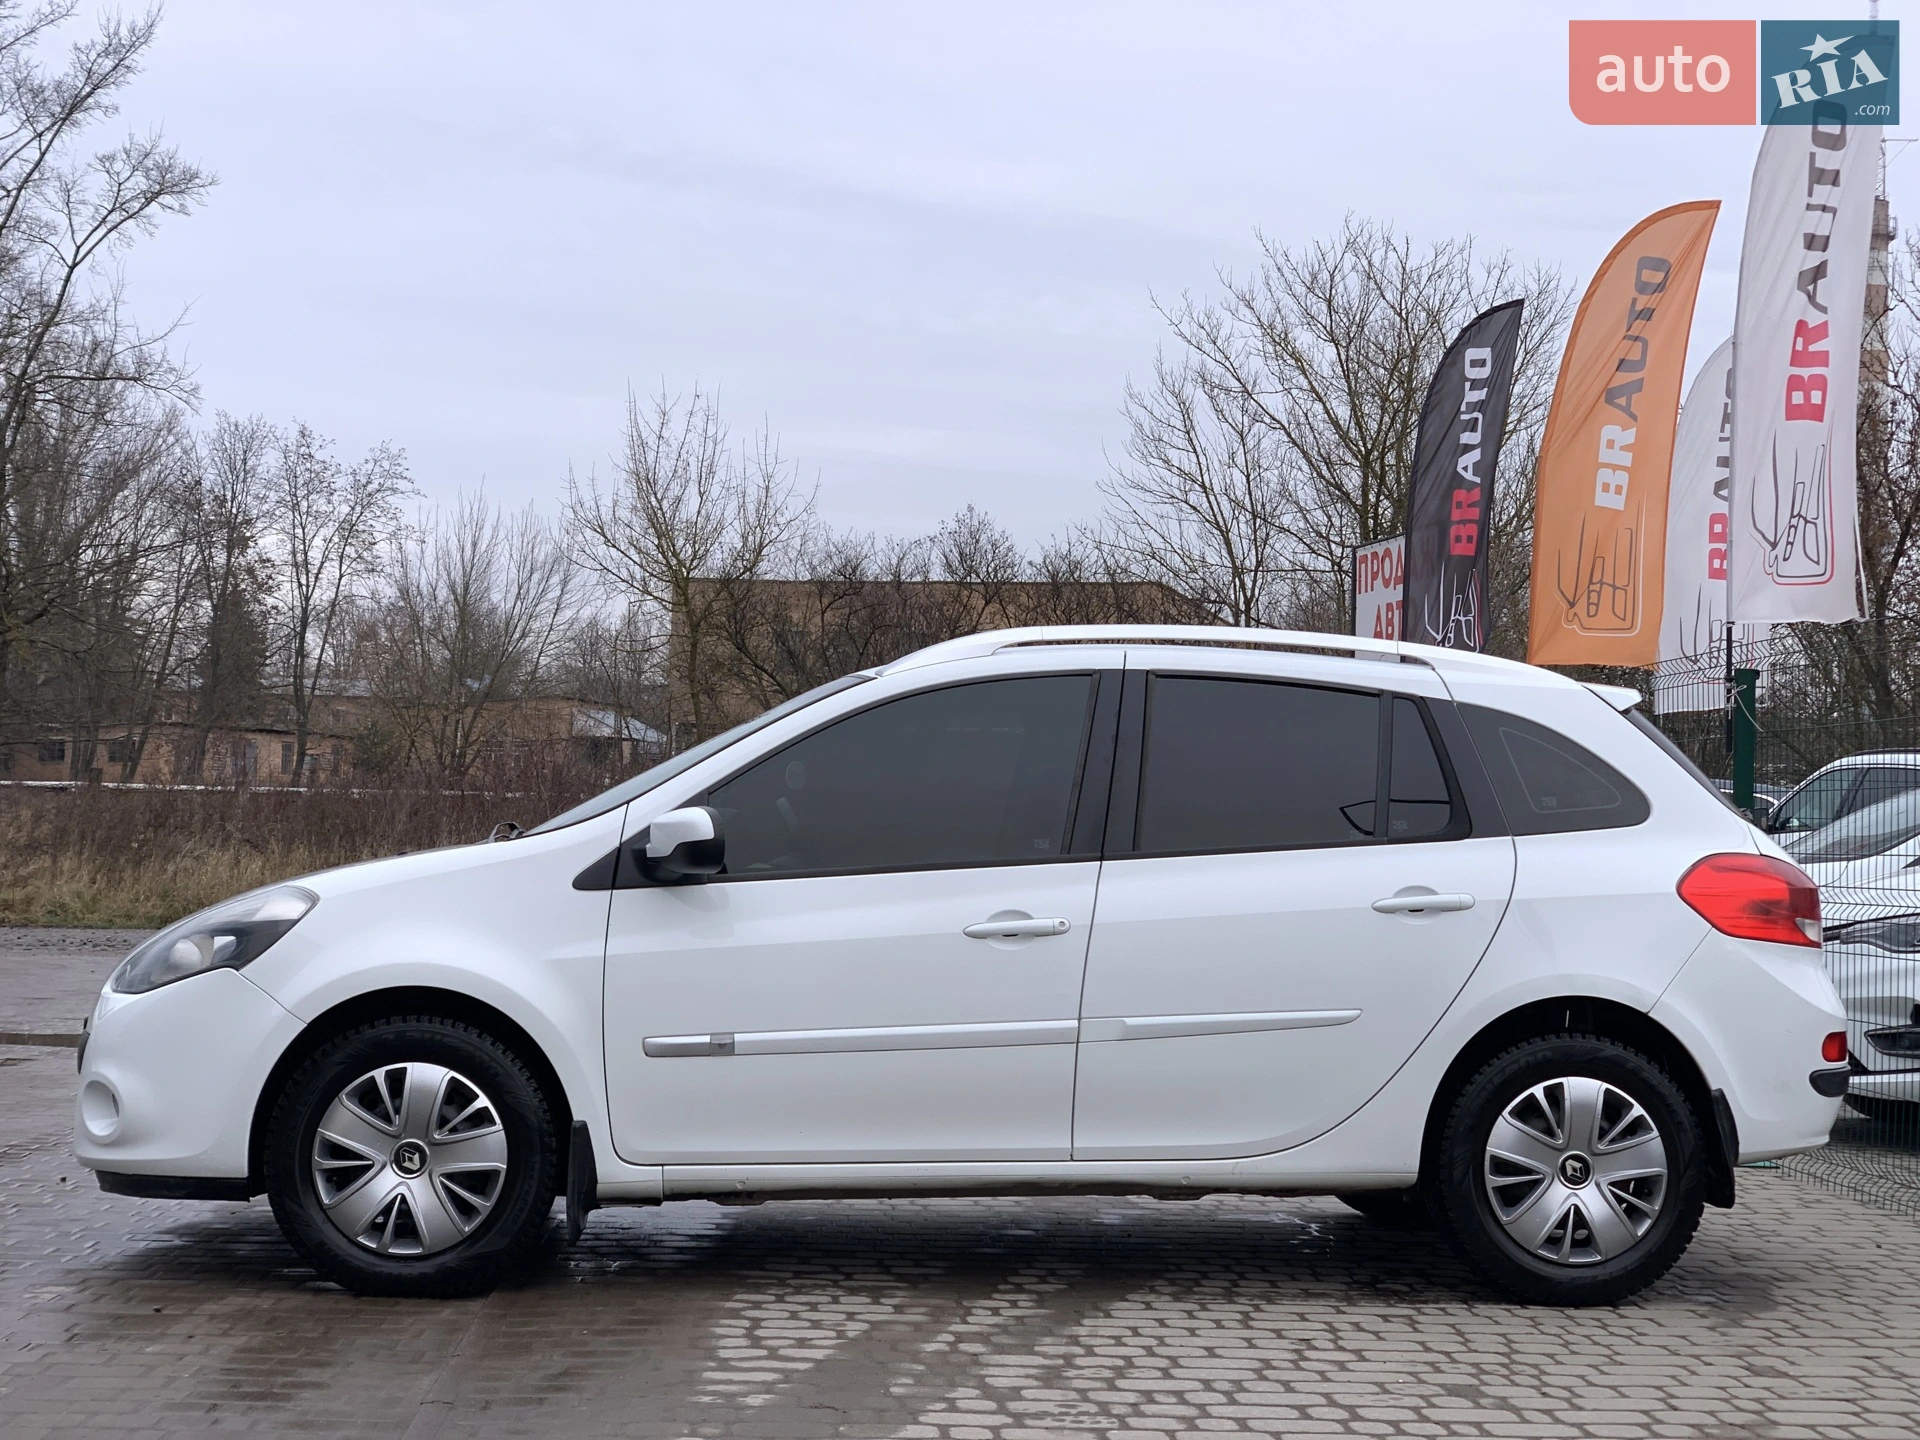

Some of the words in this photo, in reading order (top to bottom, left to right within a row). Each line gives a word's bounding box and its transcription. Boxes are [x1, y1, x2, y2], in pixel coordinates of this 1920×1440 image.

[1594, 254, 1672, 512] BRAUTO
[1784, 99, 1848, 422] BRAUTO
[1449, 346, 1492, 557] BRAUTO
